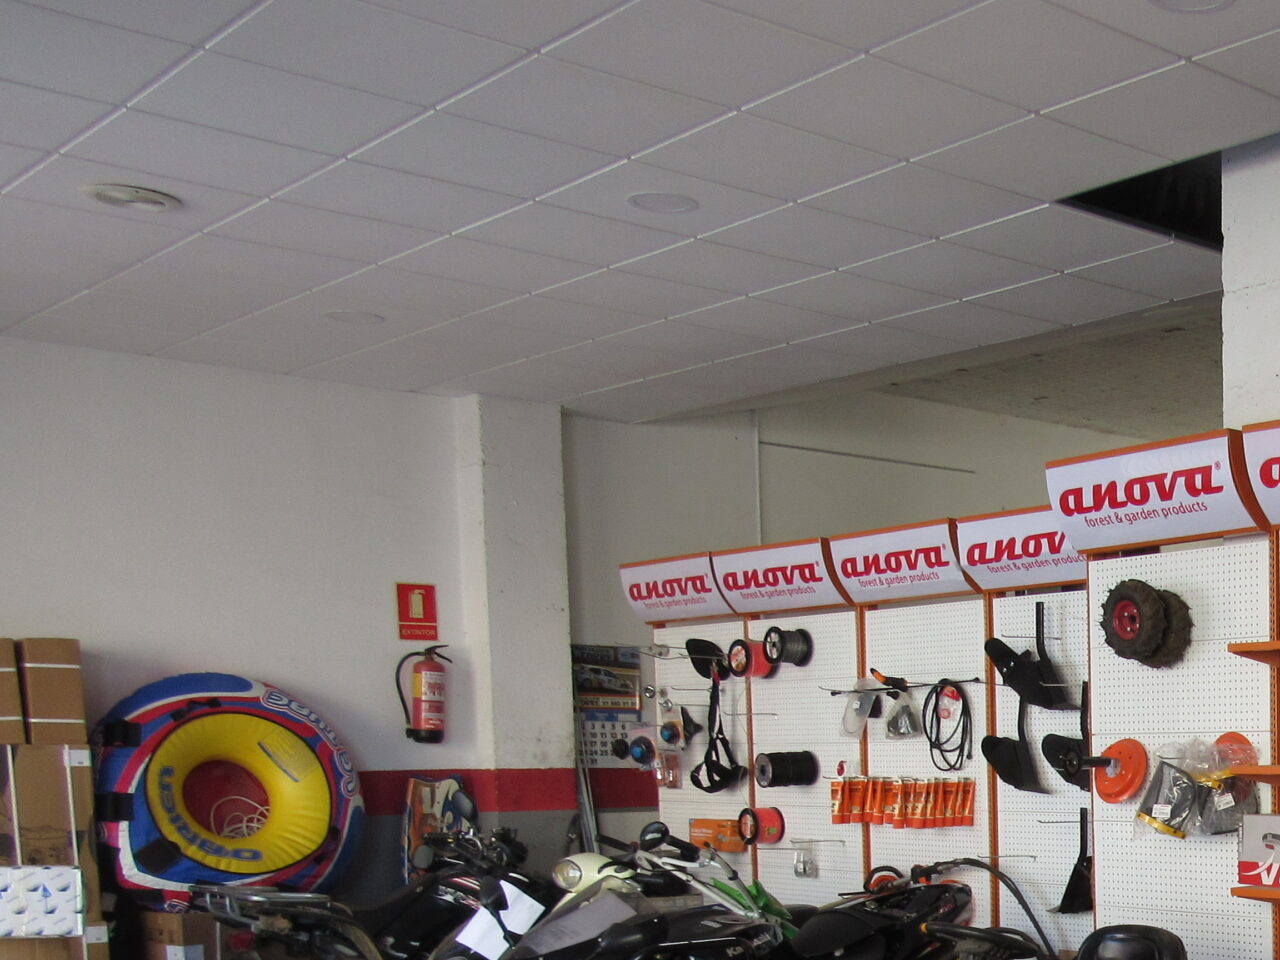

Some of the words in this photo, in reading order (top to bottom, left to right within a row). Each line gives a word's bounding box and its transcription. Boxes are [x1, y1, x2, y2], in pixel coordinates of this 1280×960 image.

[1059, 464, 1224, 517] anova
[1084, 514, 1114, 528] forest
[1115, 511, 1123, 524] &
[1124, 508, 1160, 526] garden
[1162, 500, 1208, 519] products
[841, 546, 950, 578] anova
[966, 530, 1067, 567] anov
[723, 562, 823, 591] anova
[987, 562, 1012, 574] forest
[1011, 561, 1020, 571] &
[1021, 558, 1052, 574] garden
[1052, 552, 1088, 569] product
[629, 574, 712, 601] anova
[858, 578, 878, 588] forest
[885, 574, 908, 588] garden
[908, 571, 940, 586] products
